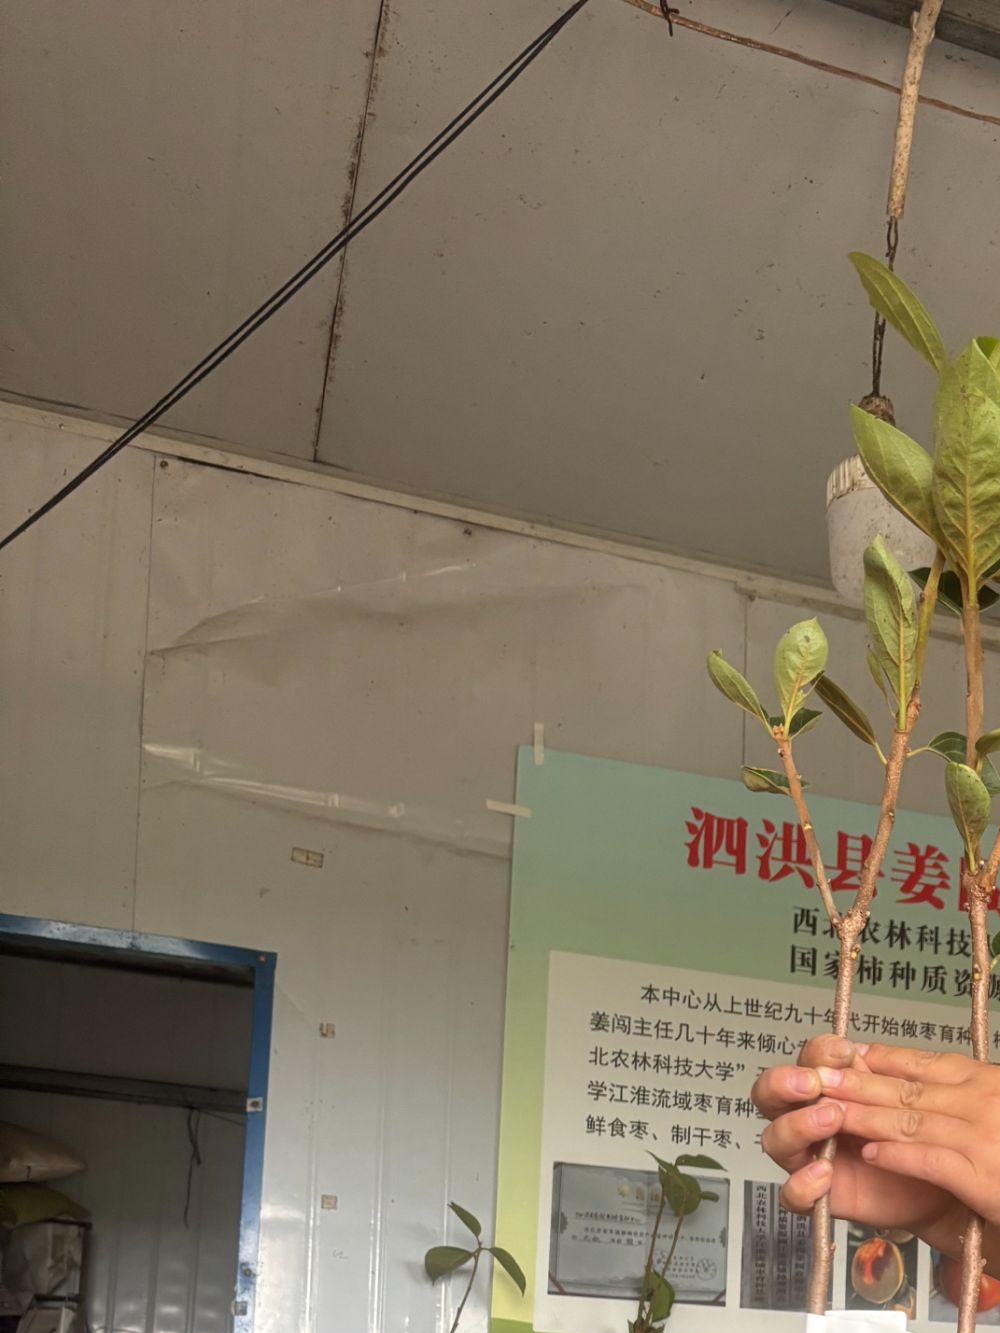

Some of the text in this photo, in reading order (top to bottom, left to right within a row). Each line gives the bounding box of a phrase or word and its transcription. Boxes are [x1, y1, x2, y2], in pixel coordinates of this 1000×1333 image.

[590, 1011, 808, 1055] 姜闯主任几十年来倾心
